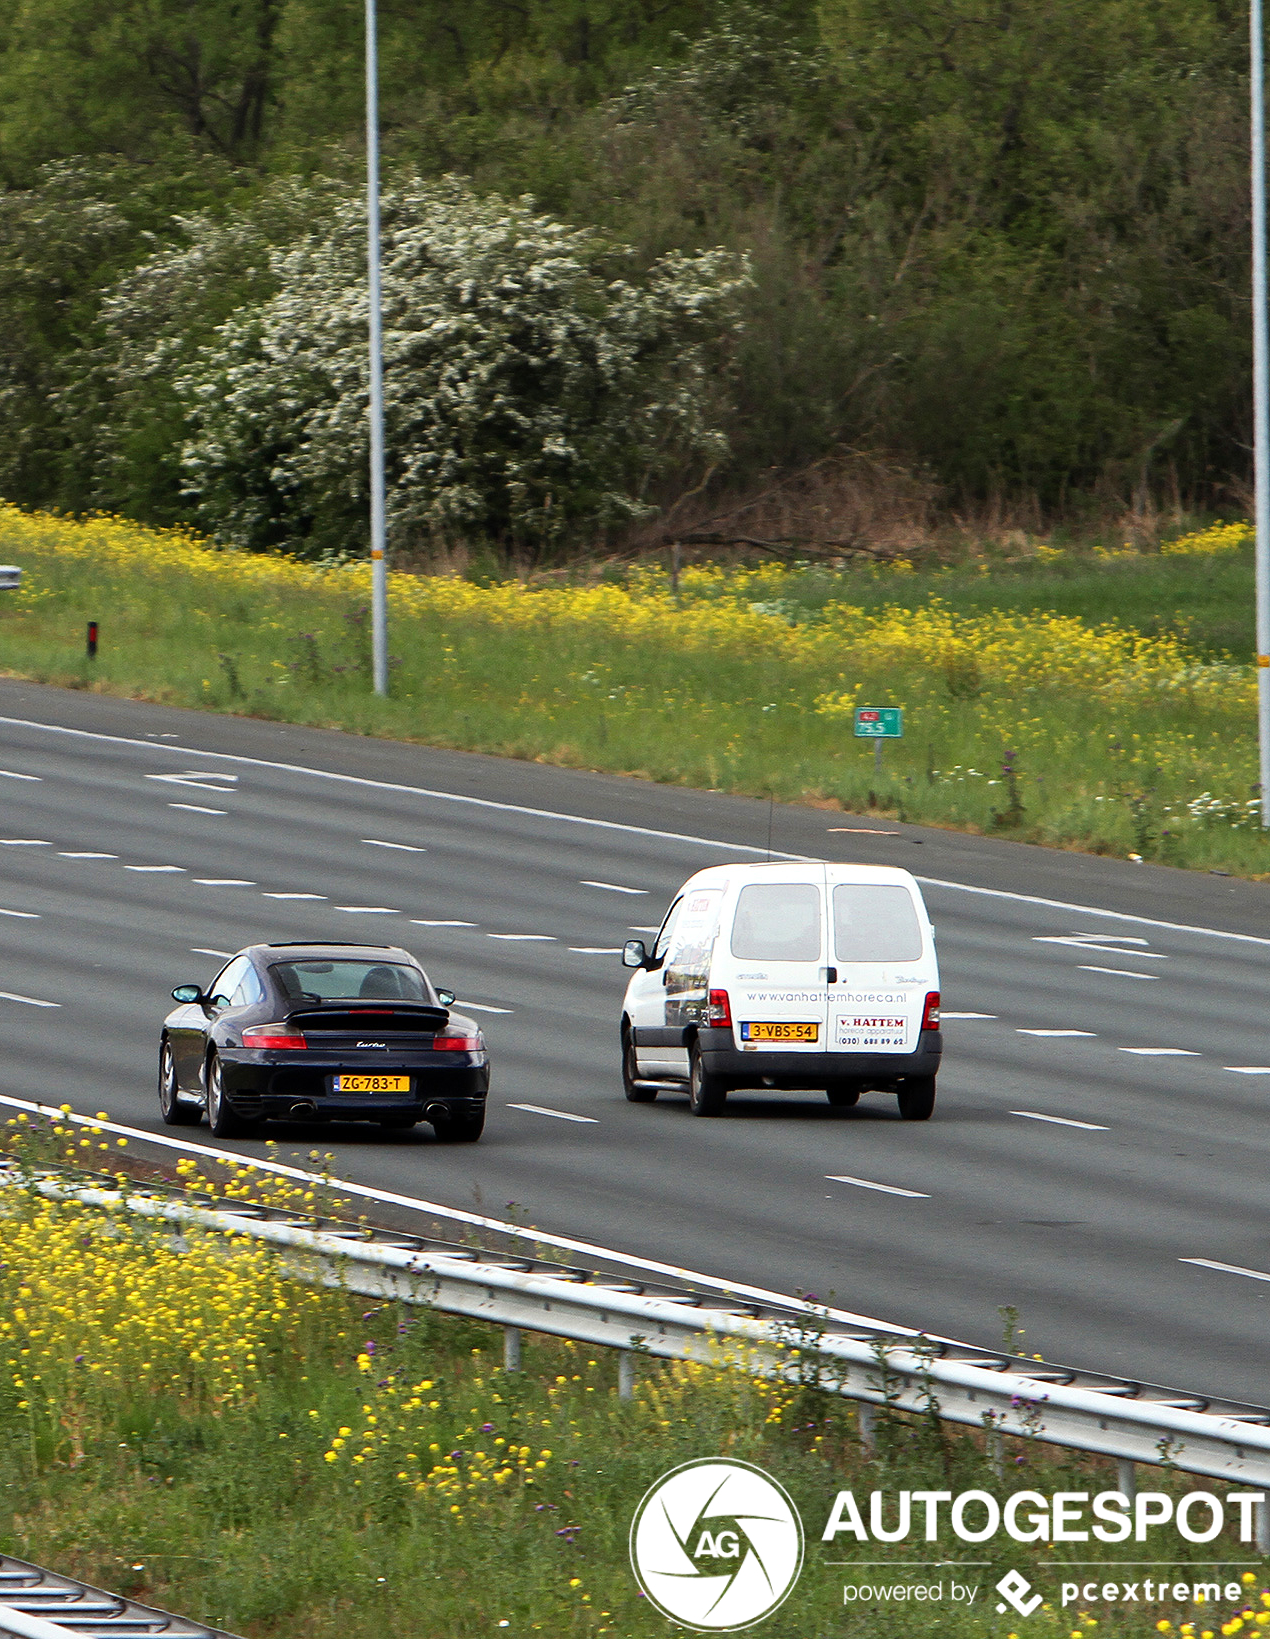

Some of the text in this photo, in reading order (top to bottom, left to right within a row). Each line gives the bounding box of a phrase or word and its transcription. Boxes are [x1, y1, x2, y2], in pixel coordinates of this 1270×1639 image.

[747, 992, 907, 1003] www.vanhattemhoreca.nl
[853, 1018, 905, 1027] HATTEM
[753, 1025, 813, 1038] 3-VBS-54
[839, 1027, 864, 1035] horeca
[838, 1037, 860, 1045] (030)
[893, 1037, 904, 1045] 62
[342, 1077, 401, 1089] ZG-783-T
